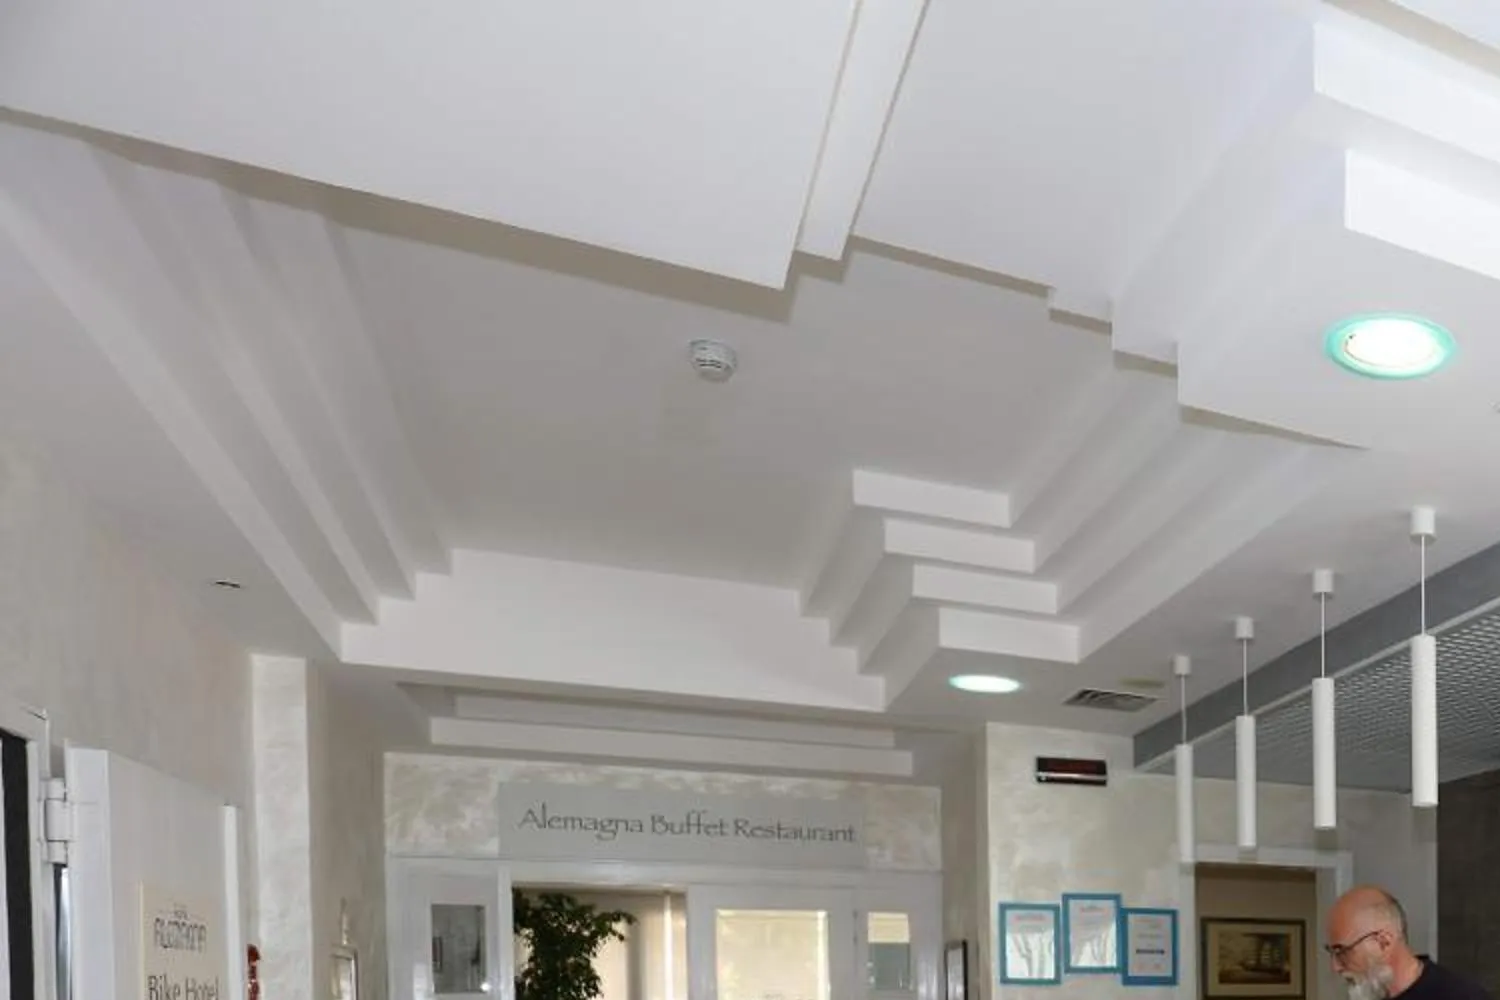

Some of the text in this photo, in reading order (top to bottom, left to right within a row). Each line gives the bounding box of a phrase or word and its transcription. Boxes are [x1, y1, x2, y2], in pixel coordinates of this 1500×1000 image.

[518, 802, 856, 843] Alemagna Buffet Restaurant
